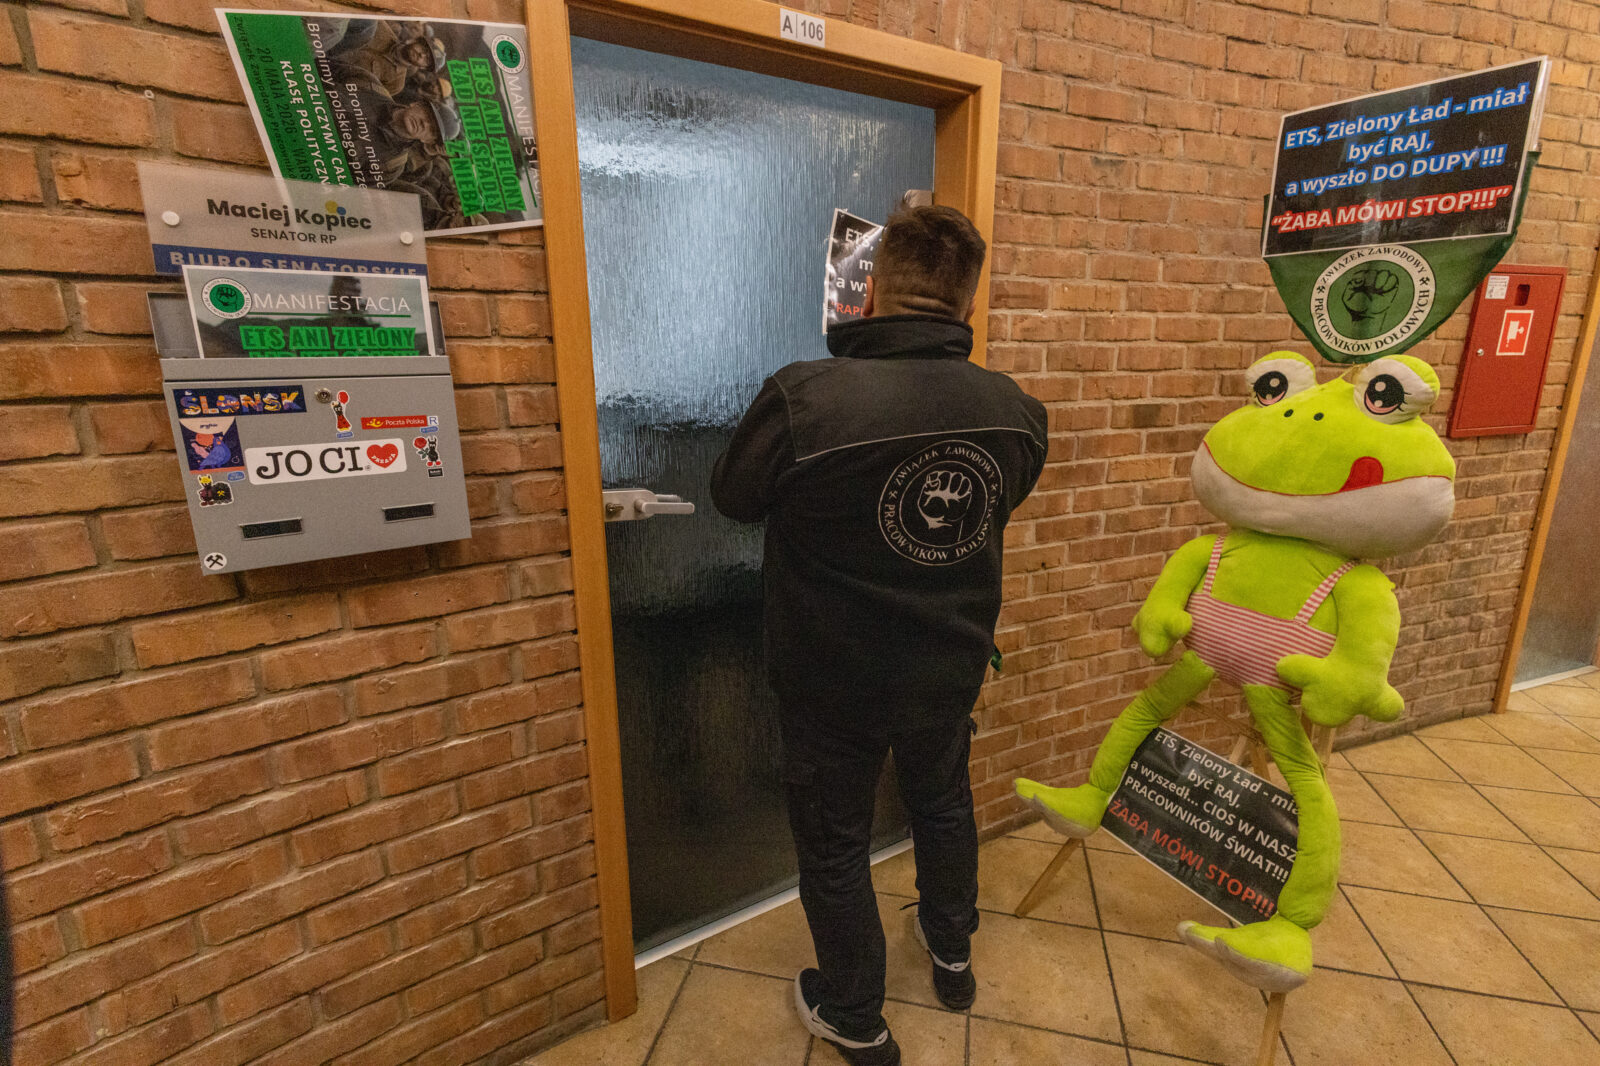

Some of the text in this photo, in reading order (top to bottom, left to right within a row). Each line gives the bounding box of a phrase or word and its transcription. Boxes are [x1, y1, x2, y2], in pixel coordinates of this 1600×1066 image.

[782, 14, 824, 42] A 106
[257, 47, 274, 63] 20
[264, 68, 283, 100] MAJA
[280, 60, 304, 105] KLASĘ
[307, 23, 335, 87] Bronimy
[326, 89, 357, 157] polskiego
[276, 103, 298, 135] 2026
[300, 63, 339, 153] ROZLICZYMY
[346, 83, 372, 143] Bronimy
[1286, 126, 1322, 148] ETS,
[1327, 112, 1404, 140] Zielony
[1408, 100, 1450, 124] Ład
[1469, 85, 1527, 112] miał
[448, 60, 505, 213] ŁAD NIE SPADŁY
[470, 58, 526, 211] ETS ANI ZIELONY
[1349, 132, 1434, 164] być RAJ,
[451, 157, 484, 216] NIEBA
[1286, 147, 1505, 195] a wyszło DO DUPY !!!
[206, 198, 373, 232] Maciej Kopiec
[1337, 196, 1406, 224] MÓWI
[250, 227, 338, 245] SENATOR RP
[169, 251, 251, 268] BIURO
[1368, 247, 1427, 275] ZAWODOWY
[836, 277, 846, 289] a
[254, 292, 411, 315] MANIFESTACJA
[1314, 289, 1431, 353] PRACOWNIKÓW DOŁOWYCH
[241, 327, 415, 349] ETS ANI ZIELONY
[429, 416, 438, 425] R
[256, 446, 364, 480] JO CI
[944, 446, 996, 480] ZAWODOWY
[884, 503, 949, 561] PRACOWNIKÓW
[1154, 731, 1178, 752] ETS,
[1180, 744, 1232, 779] Zielony
[1233, 772, 1262, 795] Ład
[1130, 760, 1139, 771] a
[1203, 800, 1236, 827] CIOS
[1237, 819, 1256, 837] W
[1187, 768, 1241, 810] być RAJ,
[1125, 775, 1290, 884] PRACOWNIKÓW ŚWIAT!!!
[1108, 799, 1276, 919] ŻABA MÓWI STOP!!!
